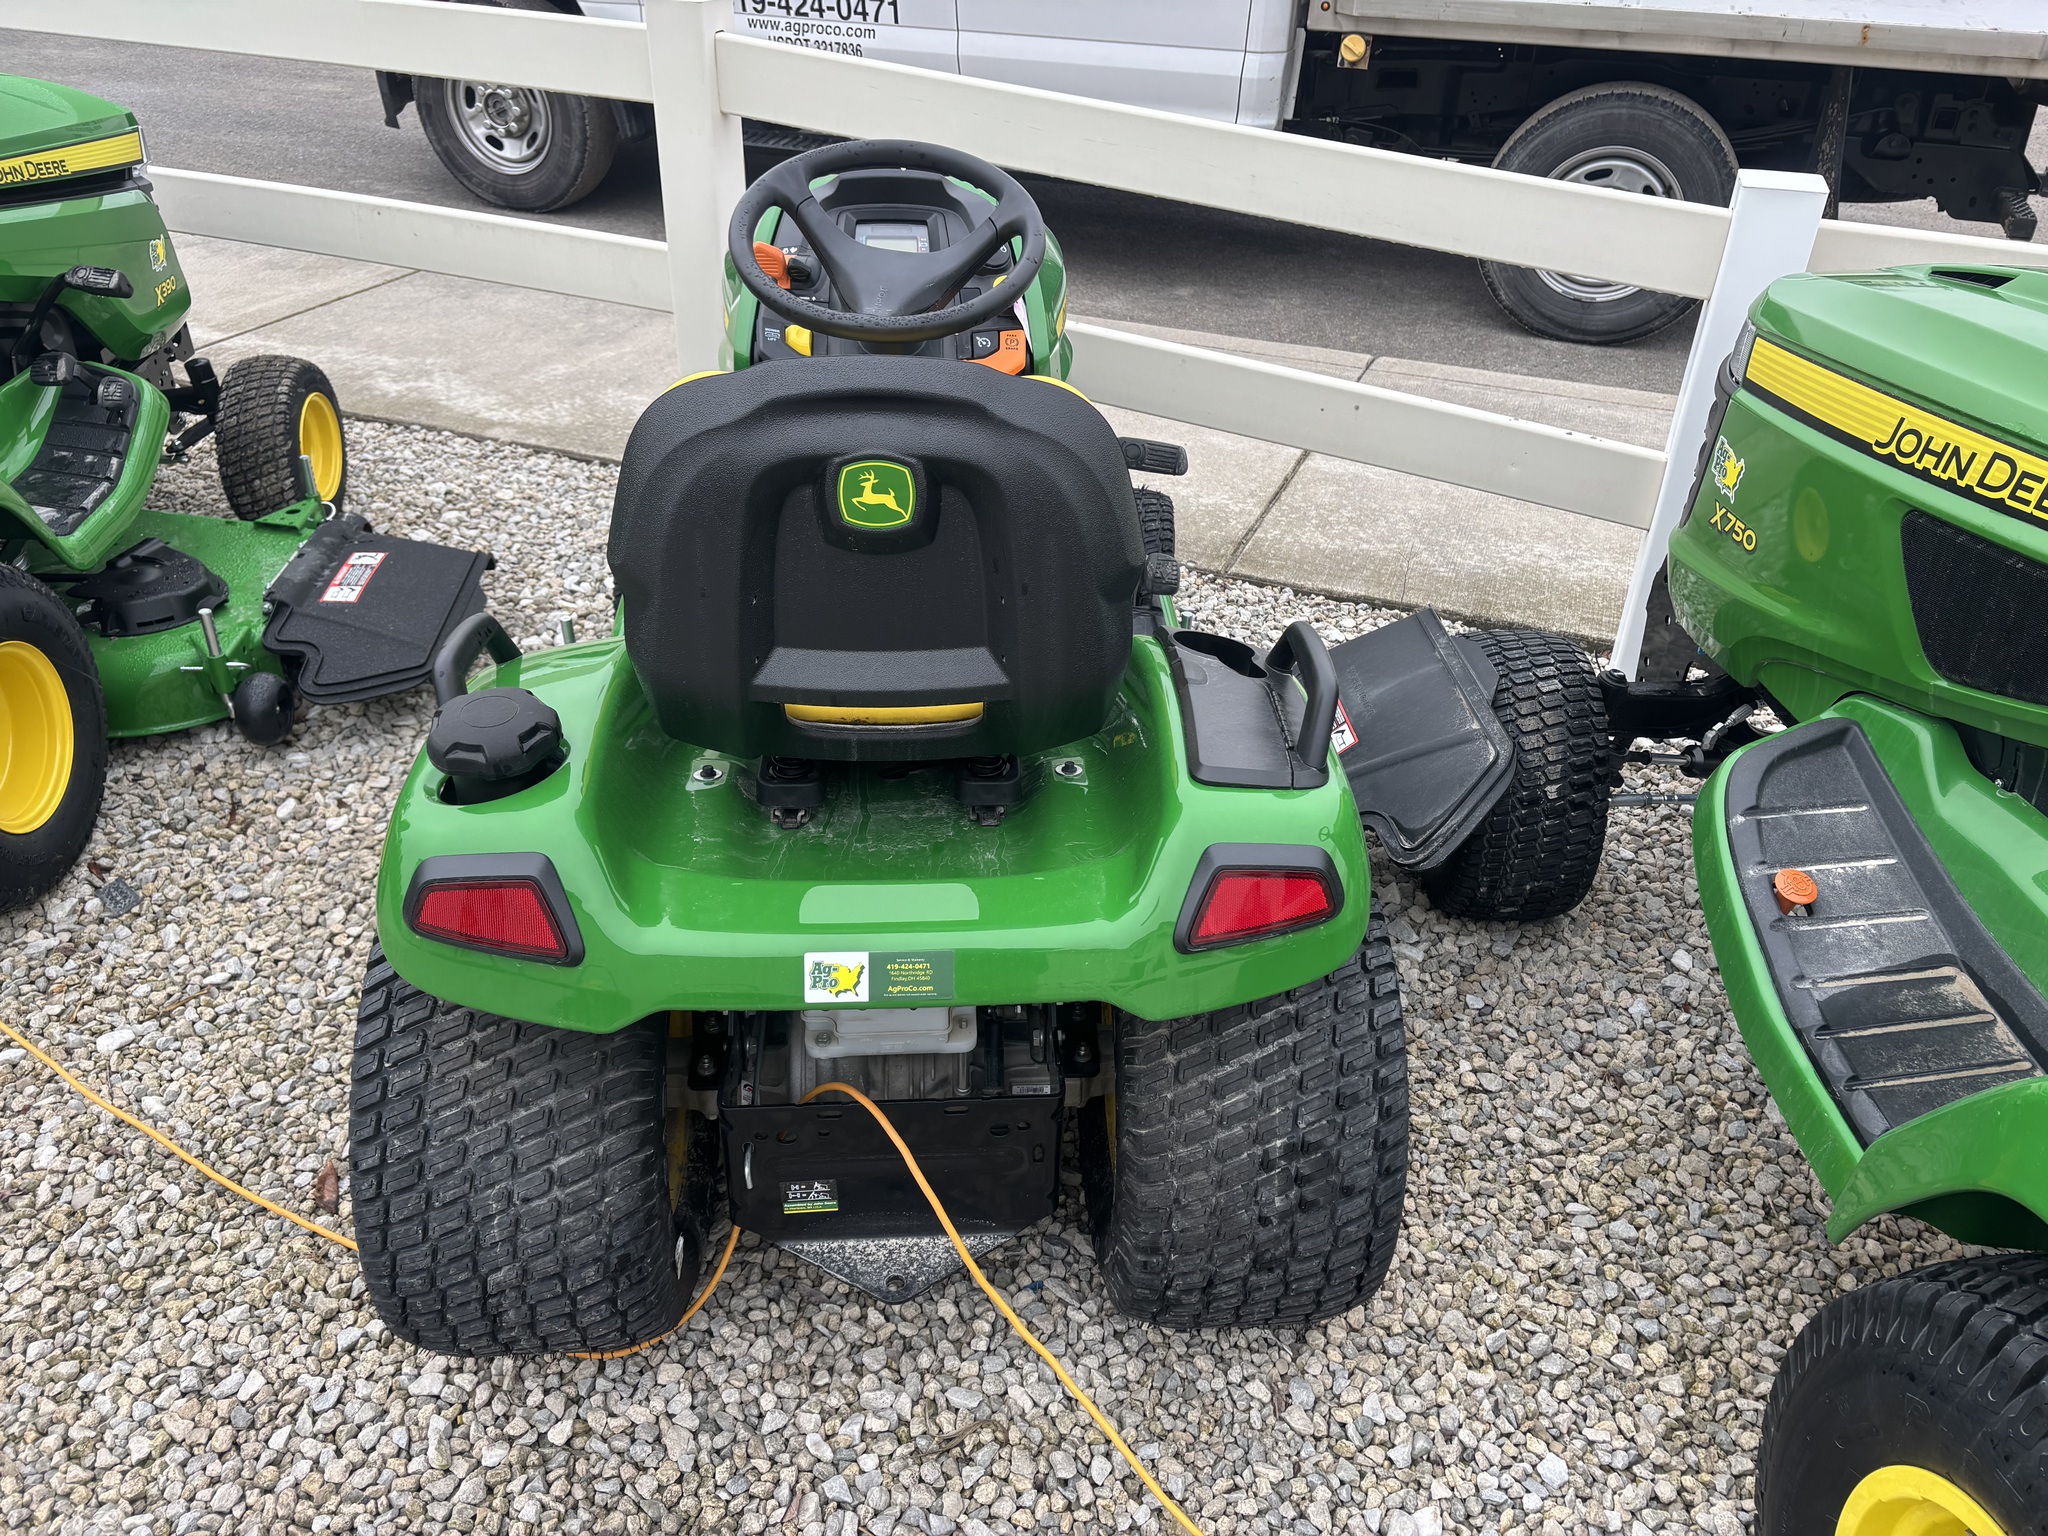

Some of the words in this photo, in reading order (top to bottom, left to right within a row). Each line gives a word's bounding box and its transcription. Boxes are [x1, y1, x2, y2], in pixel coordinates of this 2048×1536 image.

[733, 0, 899, 25] 19-424-0471
[746, 18, 877, 40] www.agproco.com
[24, 159, 70, 179] DEERE
[154, 275, 177, 308] X390
[1873, 416, 1978, 482] JOHN
[1974, 451, 2048, 515] DE
[1708, 500, 1758, 552] X750
[811, 962, 838, 977] Ag-
[811, 976, 838, 988] Pro
[888, 985, 934, 993] AgProCo.com
